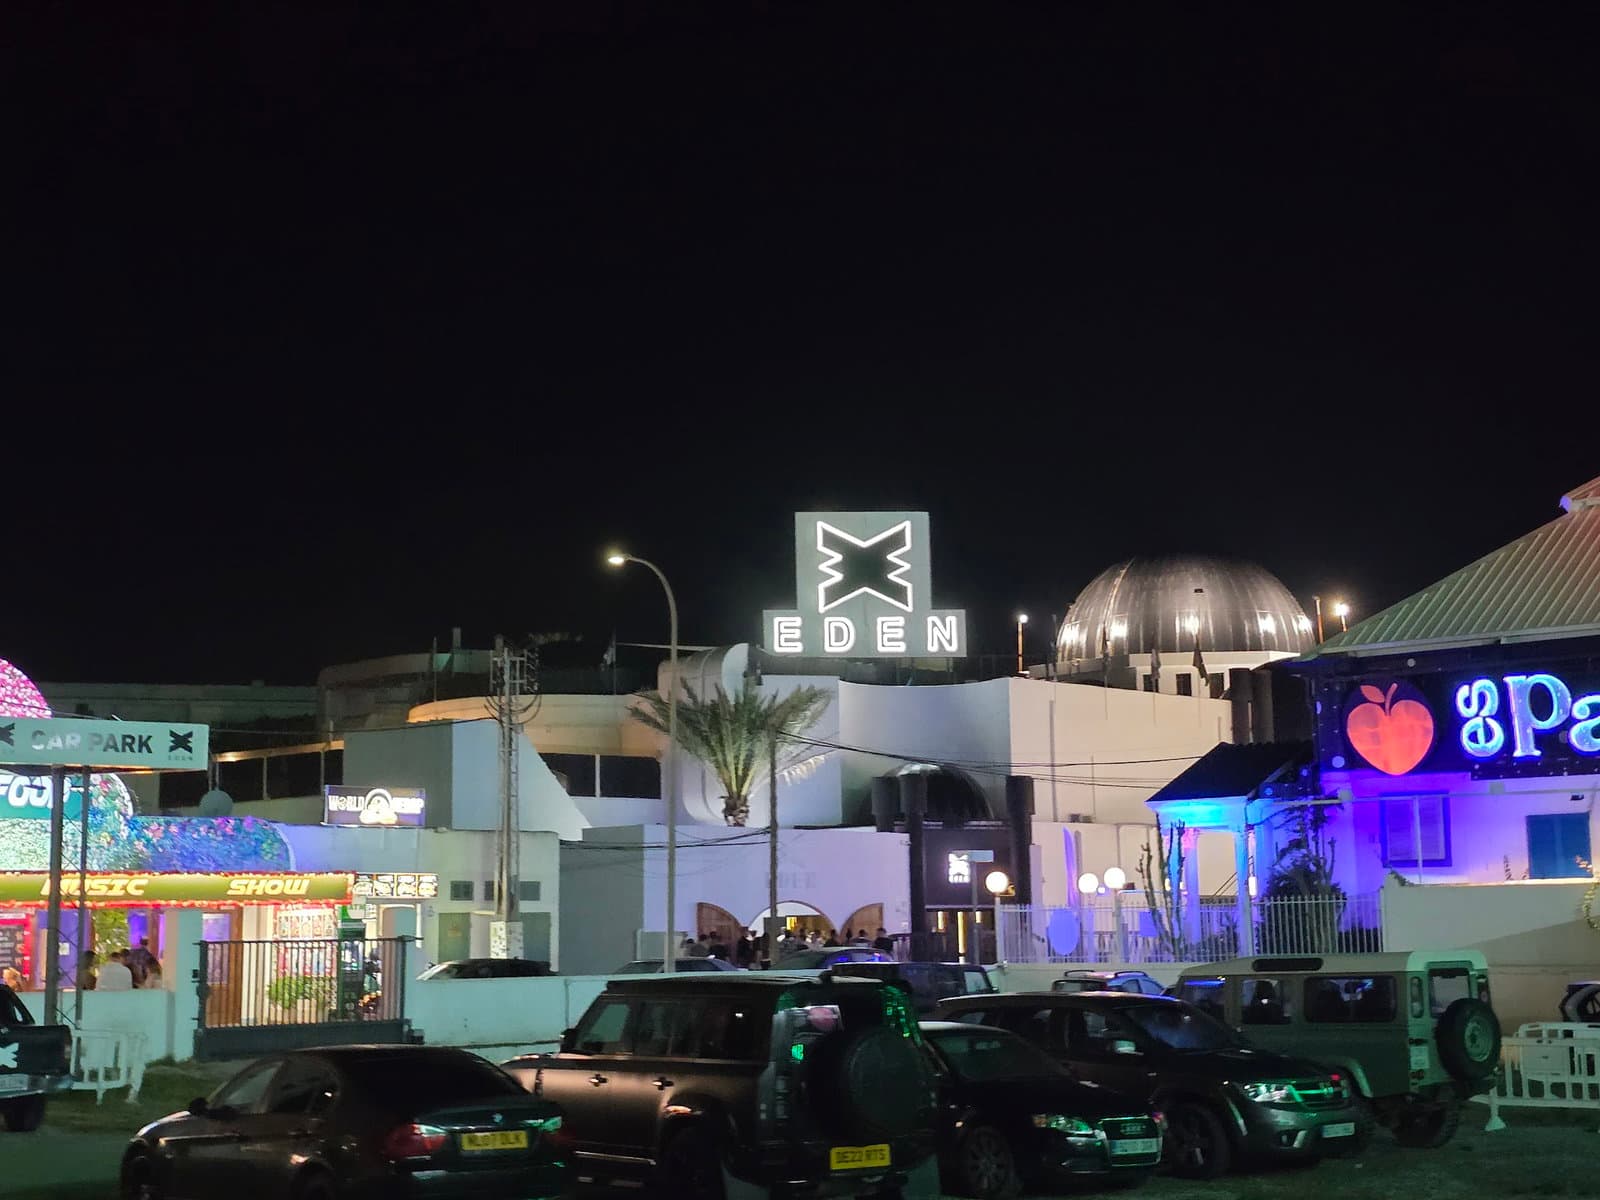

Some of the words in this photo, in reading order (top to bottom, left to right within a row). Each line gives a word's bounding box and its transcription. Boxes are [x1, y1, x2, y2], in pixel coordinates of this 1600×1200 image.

[773, 616, 958, 653] EDEN
[31, 730, 81, 751] CAR
[89, 733, 153, 754] PARK
[226, 878, 311, 896] SHOW
